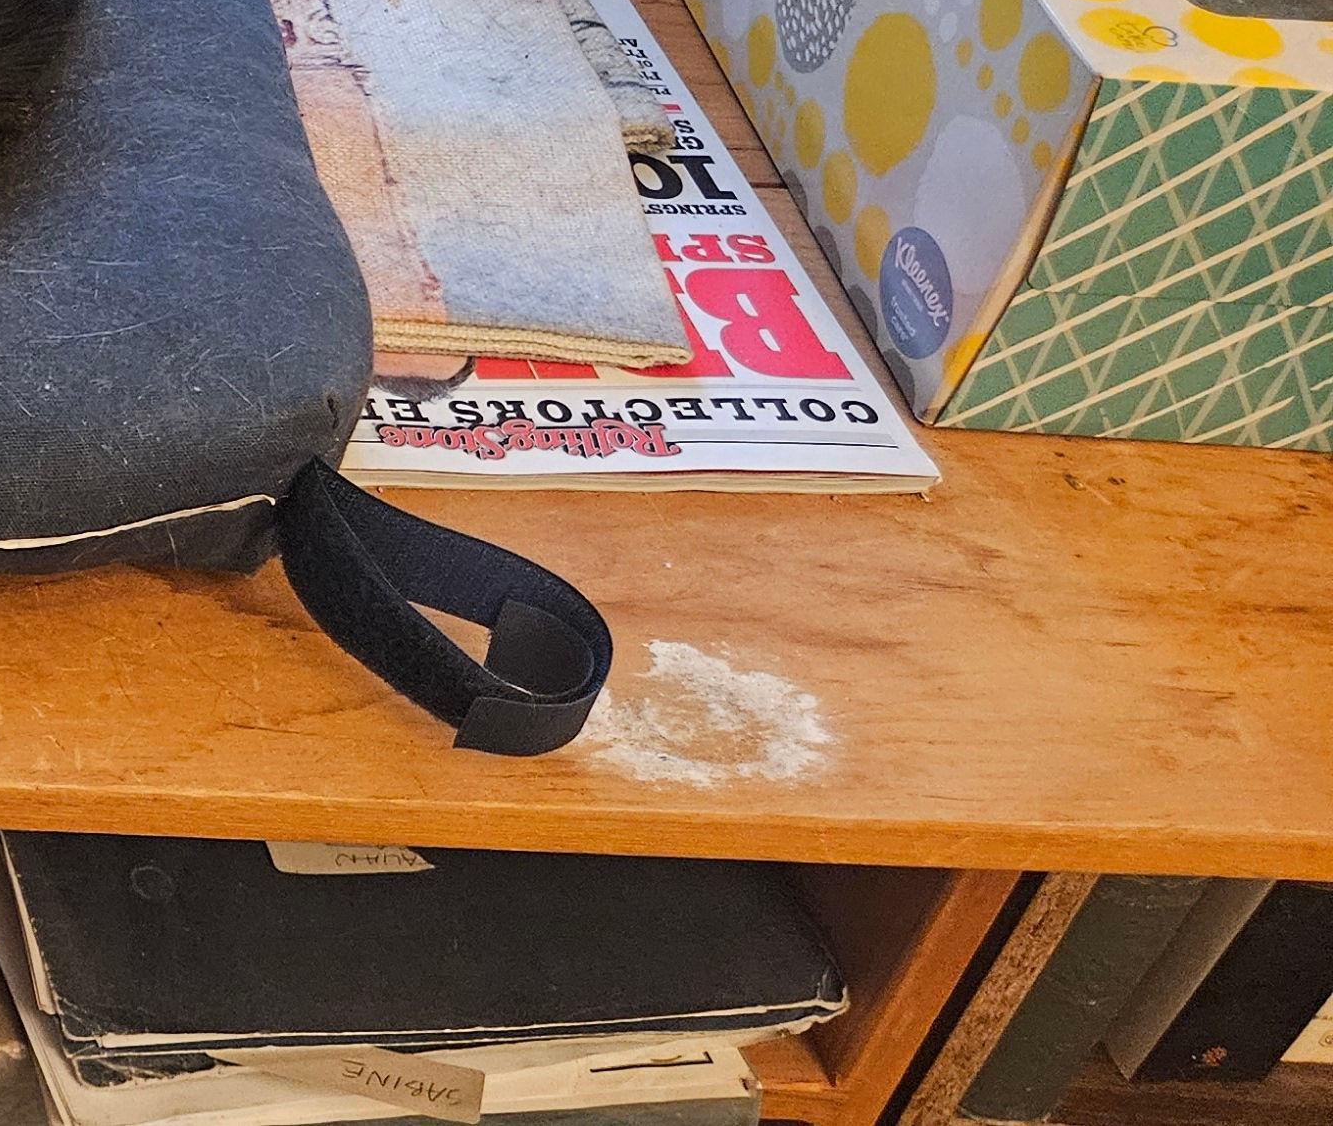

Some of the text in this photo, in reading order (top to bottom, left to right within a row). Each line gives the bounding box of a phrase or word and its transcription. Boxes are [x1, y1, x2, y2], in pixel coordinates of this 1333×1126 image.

[894, 236, 947, 327] Kleenex
[452, 397, 880, 425] COLLECTORS
[340, 1058, 461, 1106] SABINE
